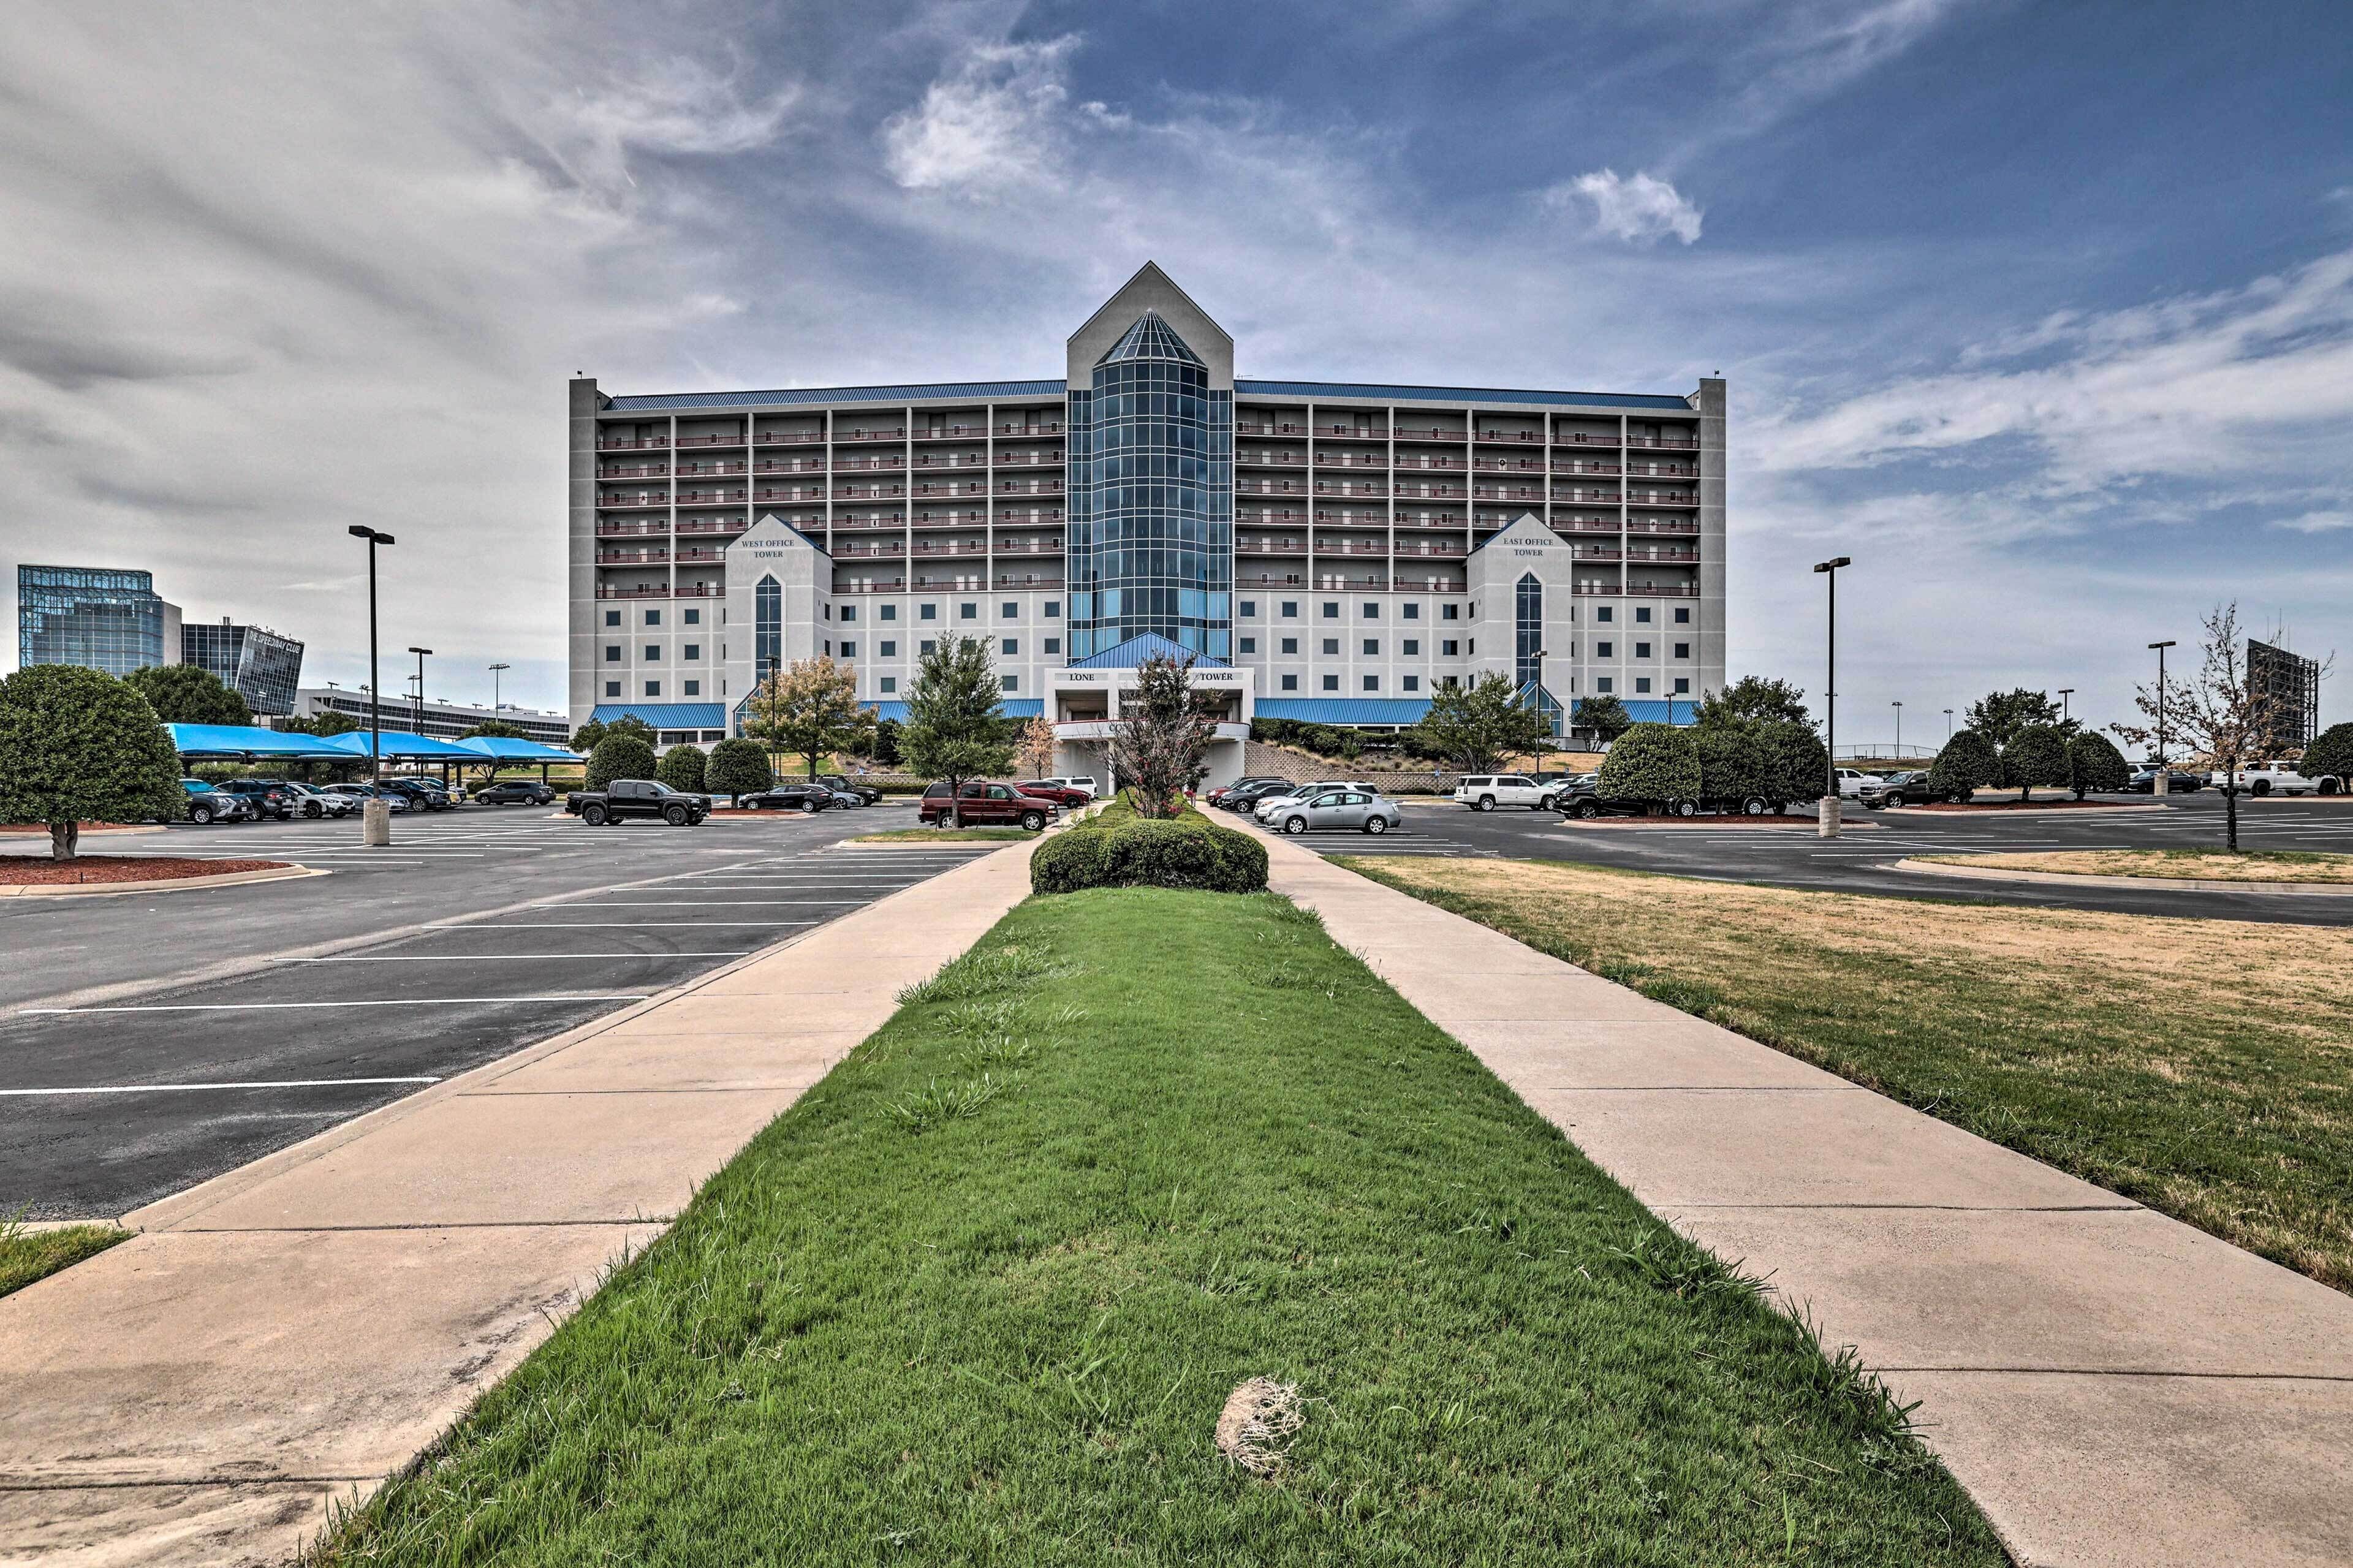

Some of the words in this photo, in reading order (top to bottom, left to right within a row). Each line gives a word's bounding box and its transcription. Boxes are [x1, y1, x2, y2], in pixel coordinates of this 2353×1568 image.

[249, 631, 258, 641] THE
[258, 634, 286, 650] SPEEDWAY
[286, 643, 301, 654] CLUB
